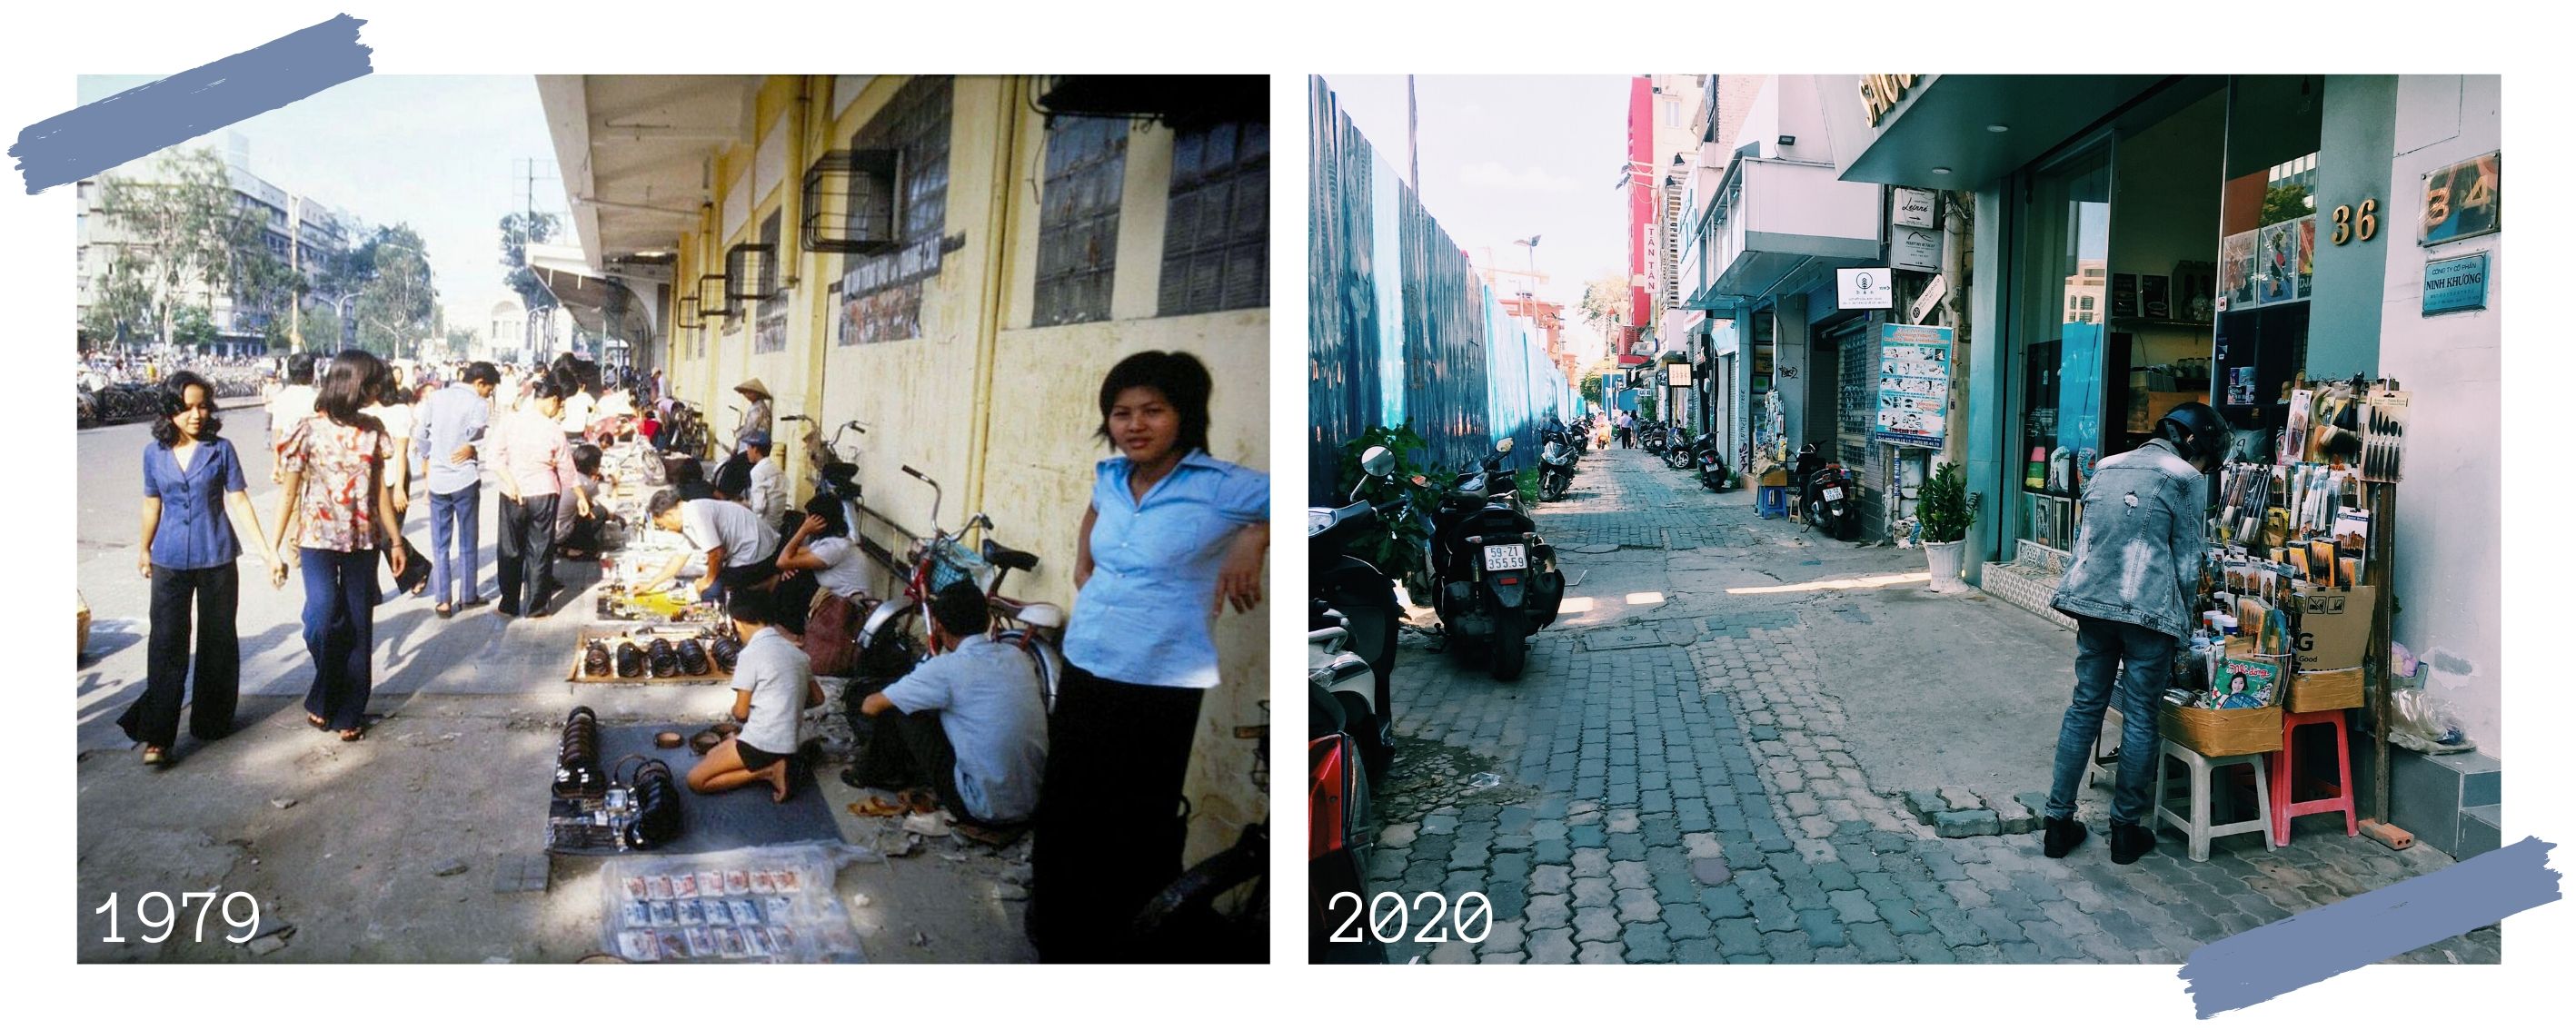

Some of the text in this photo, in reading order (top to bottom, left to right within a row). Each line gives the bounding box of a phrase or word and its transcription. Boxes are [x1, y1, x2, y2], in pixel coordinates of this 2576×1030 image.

[2331, 198, 2377, 246] 36
[2426, 272, 2482, 291] NINH KHƯƠNG
[1490, 547, 1517, 557] 59-Z1
[1488, 558, 1524, 569] 355.59
